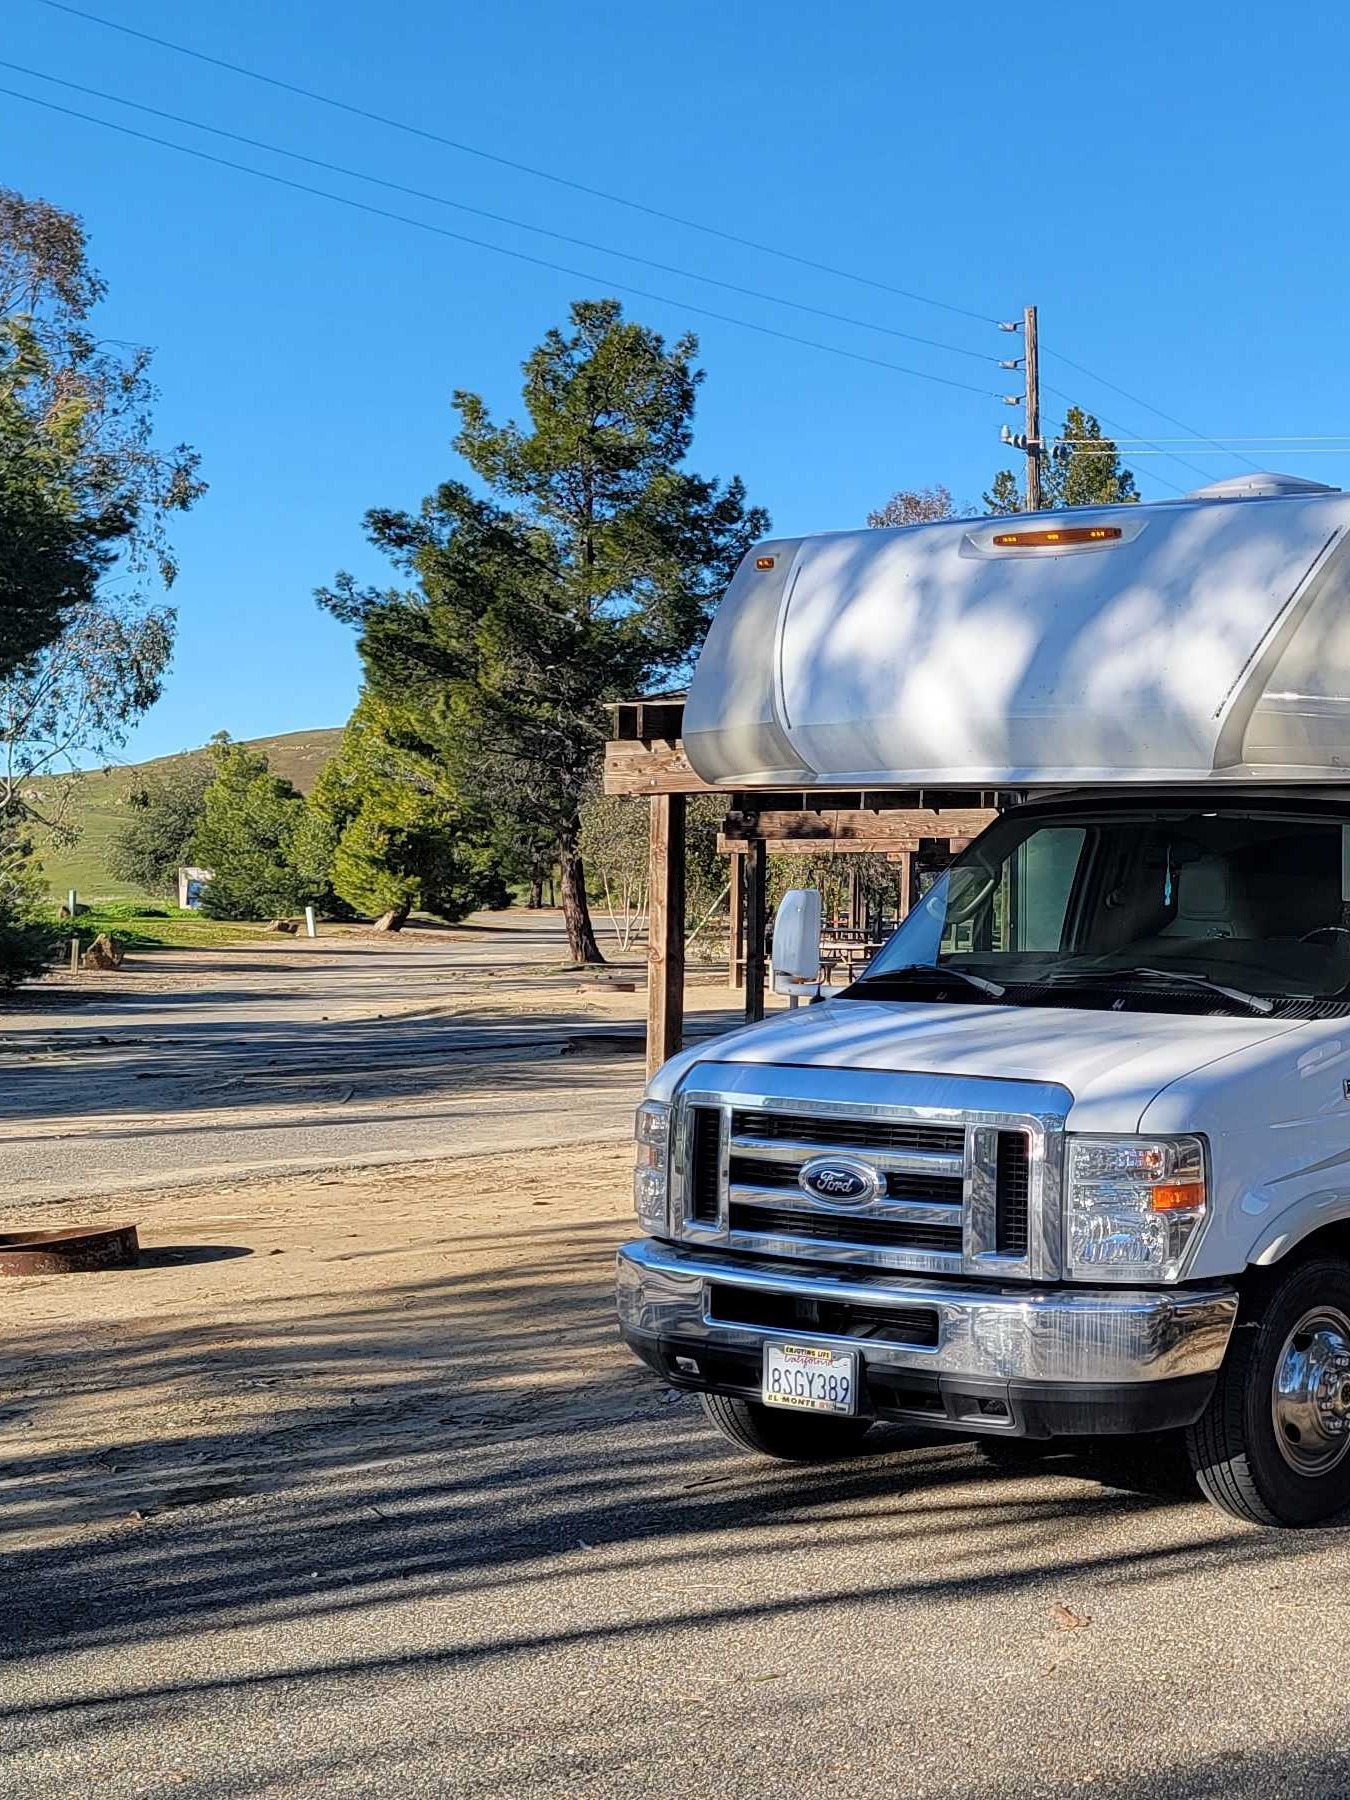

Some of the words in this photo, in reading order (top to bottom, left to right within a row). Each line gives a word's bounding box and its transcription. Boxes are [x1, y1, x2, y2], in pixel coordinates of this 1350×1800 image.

[816, 1170, 854, 1193] Ford
[772, 1367, 850, 1403] 8SGY389
[768, 1394, 779, 1402] EL
[781, 1396, 816, 1407] MONTE
